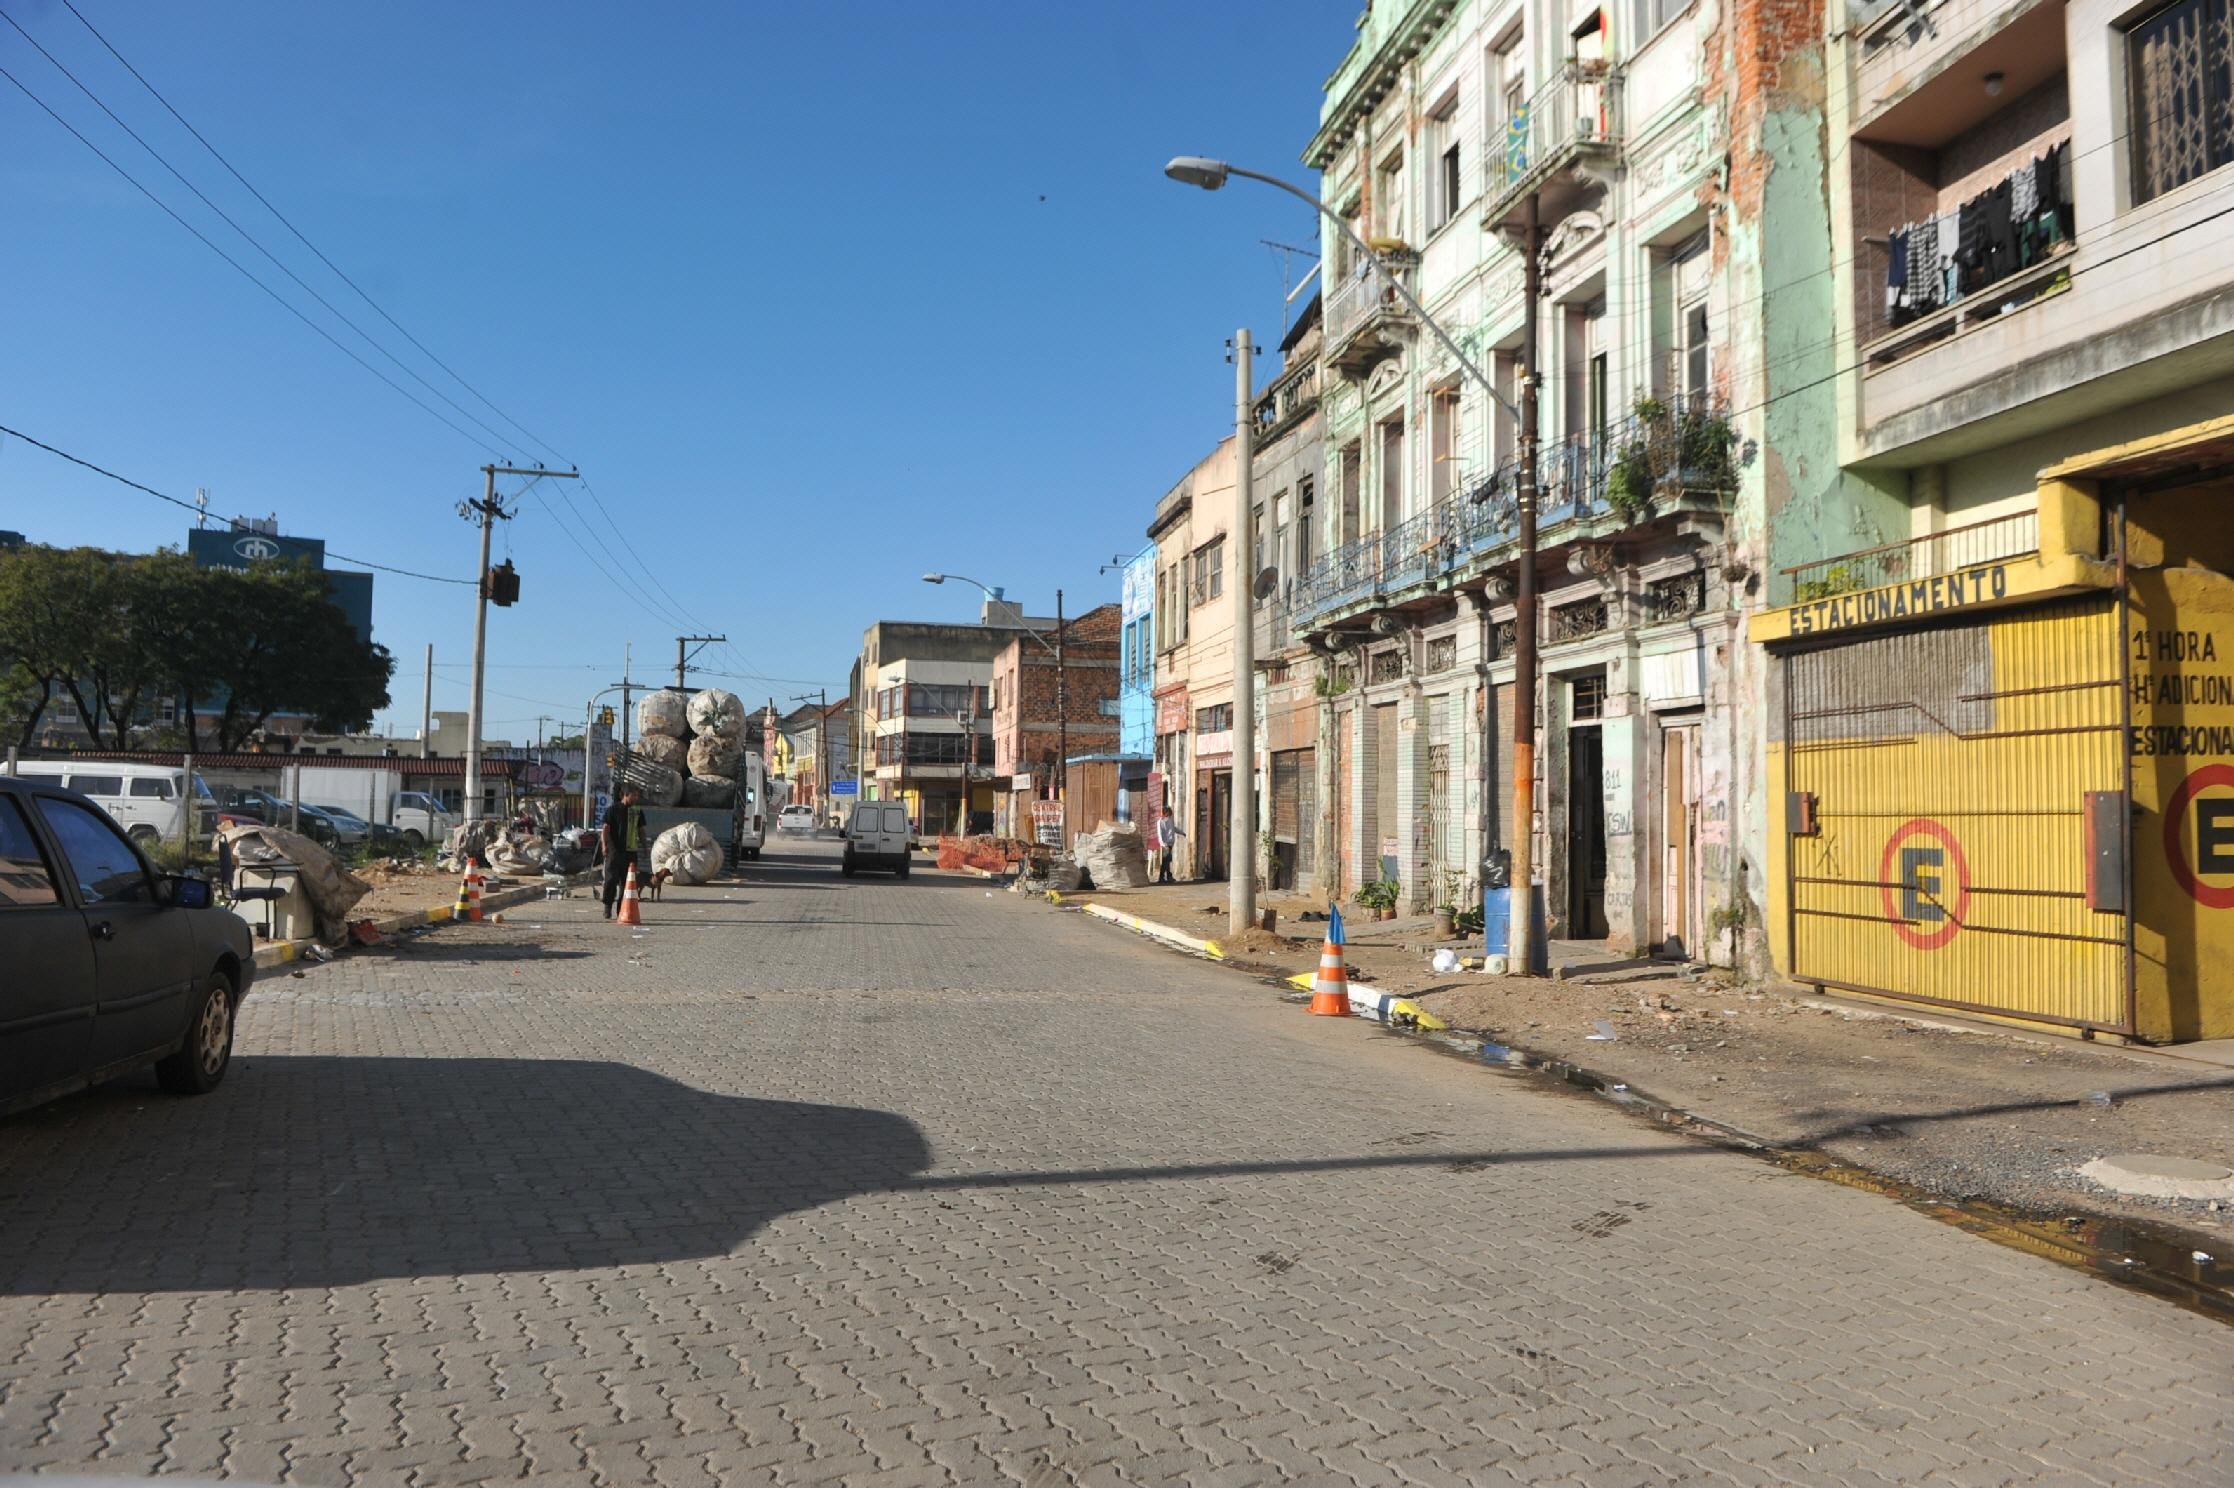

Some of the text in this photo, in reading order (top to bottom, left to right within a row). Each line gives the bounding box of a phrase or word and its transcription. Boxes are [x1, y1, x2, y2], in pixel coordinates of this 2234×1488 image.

[1789, 565, 2006, 637] ESTACIONAMENTO
[2158, 630, 2217, 662] HORA
[2157, 674, 2234, 706] ADICION
[1902, 847, 1944, 922] E
